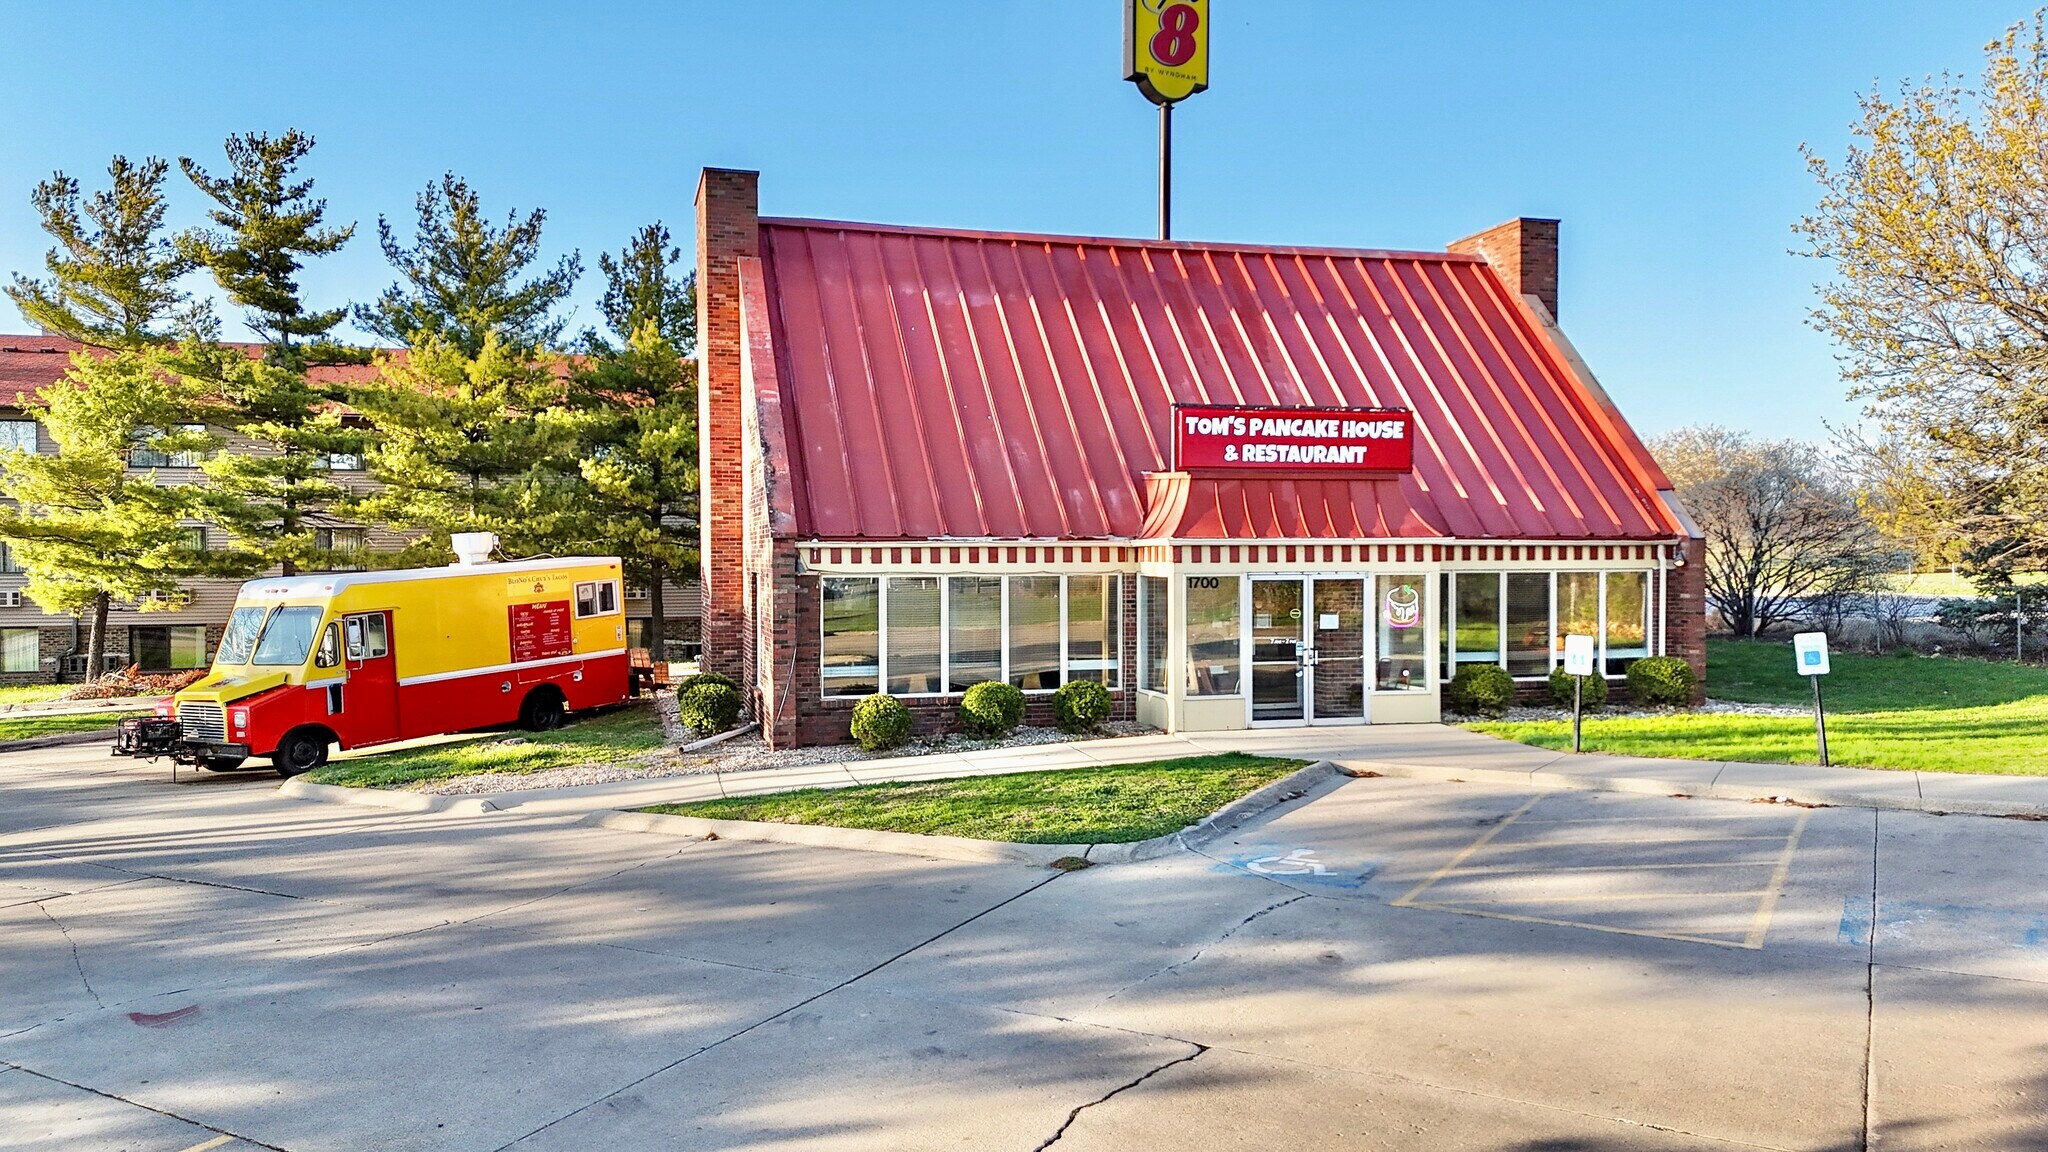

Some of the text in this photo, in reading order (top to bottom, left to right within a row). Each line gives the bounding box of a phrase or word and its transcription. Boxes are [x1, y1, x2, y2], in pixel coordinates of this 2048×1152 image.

[1149, 3, 1199, 67] 8
[1158, 70, 1196, 81] WYNDHAM
[1185, 416, 1405, 439] TOM'S PANCAKE HOUSE
[1223, 444, 1367, 464] & RESTAURANT
[1188, 577, 1219, 588] 1700
